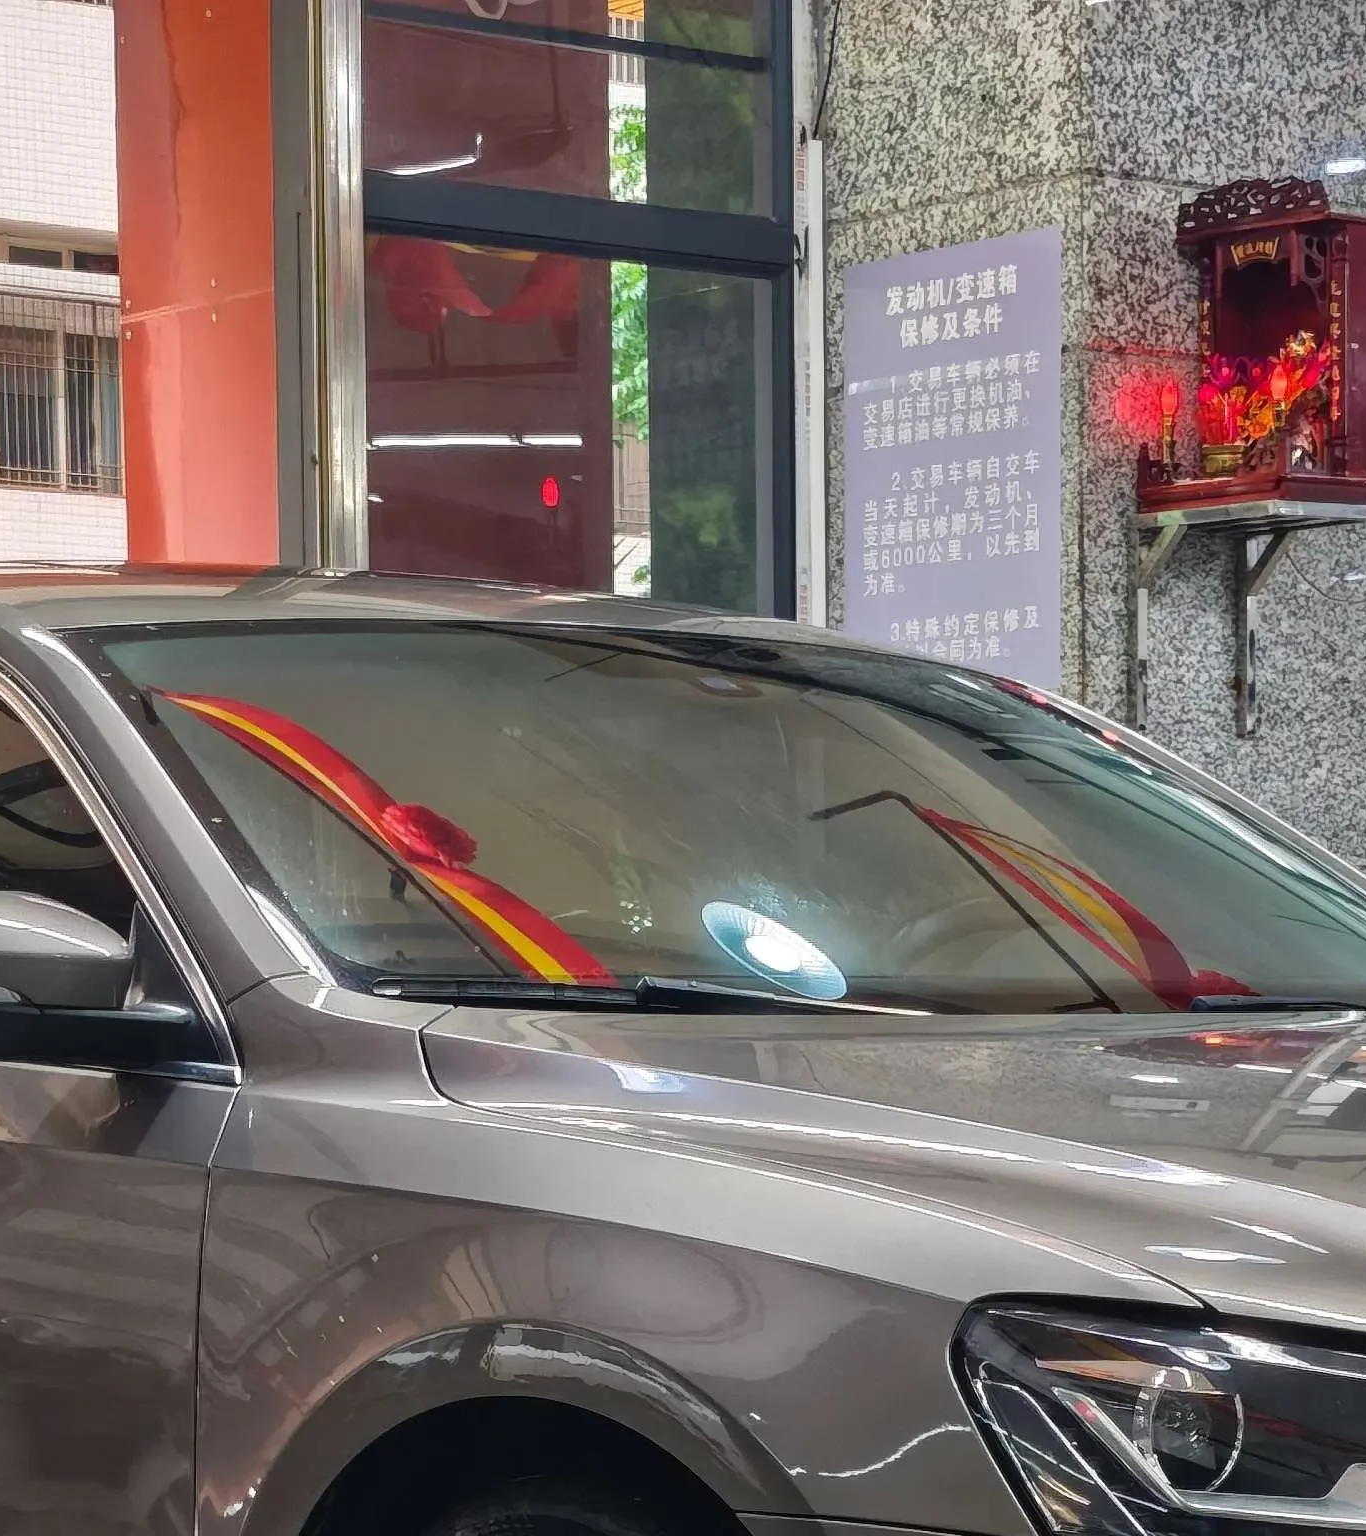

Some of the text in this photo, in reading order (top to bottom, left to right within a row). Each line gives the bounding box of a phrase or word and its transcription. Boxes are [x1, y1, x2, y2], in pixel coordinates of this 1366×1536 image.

[886, 264, 1018, 316] 发动机/变速箱
[900, 302, 1003, 348] 保修及条件
[863, 503, 1039, 548] 变速箱保修期为三个月
